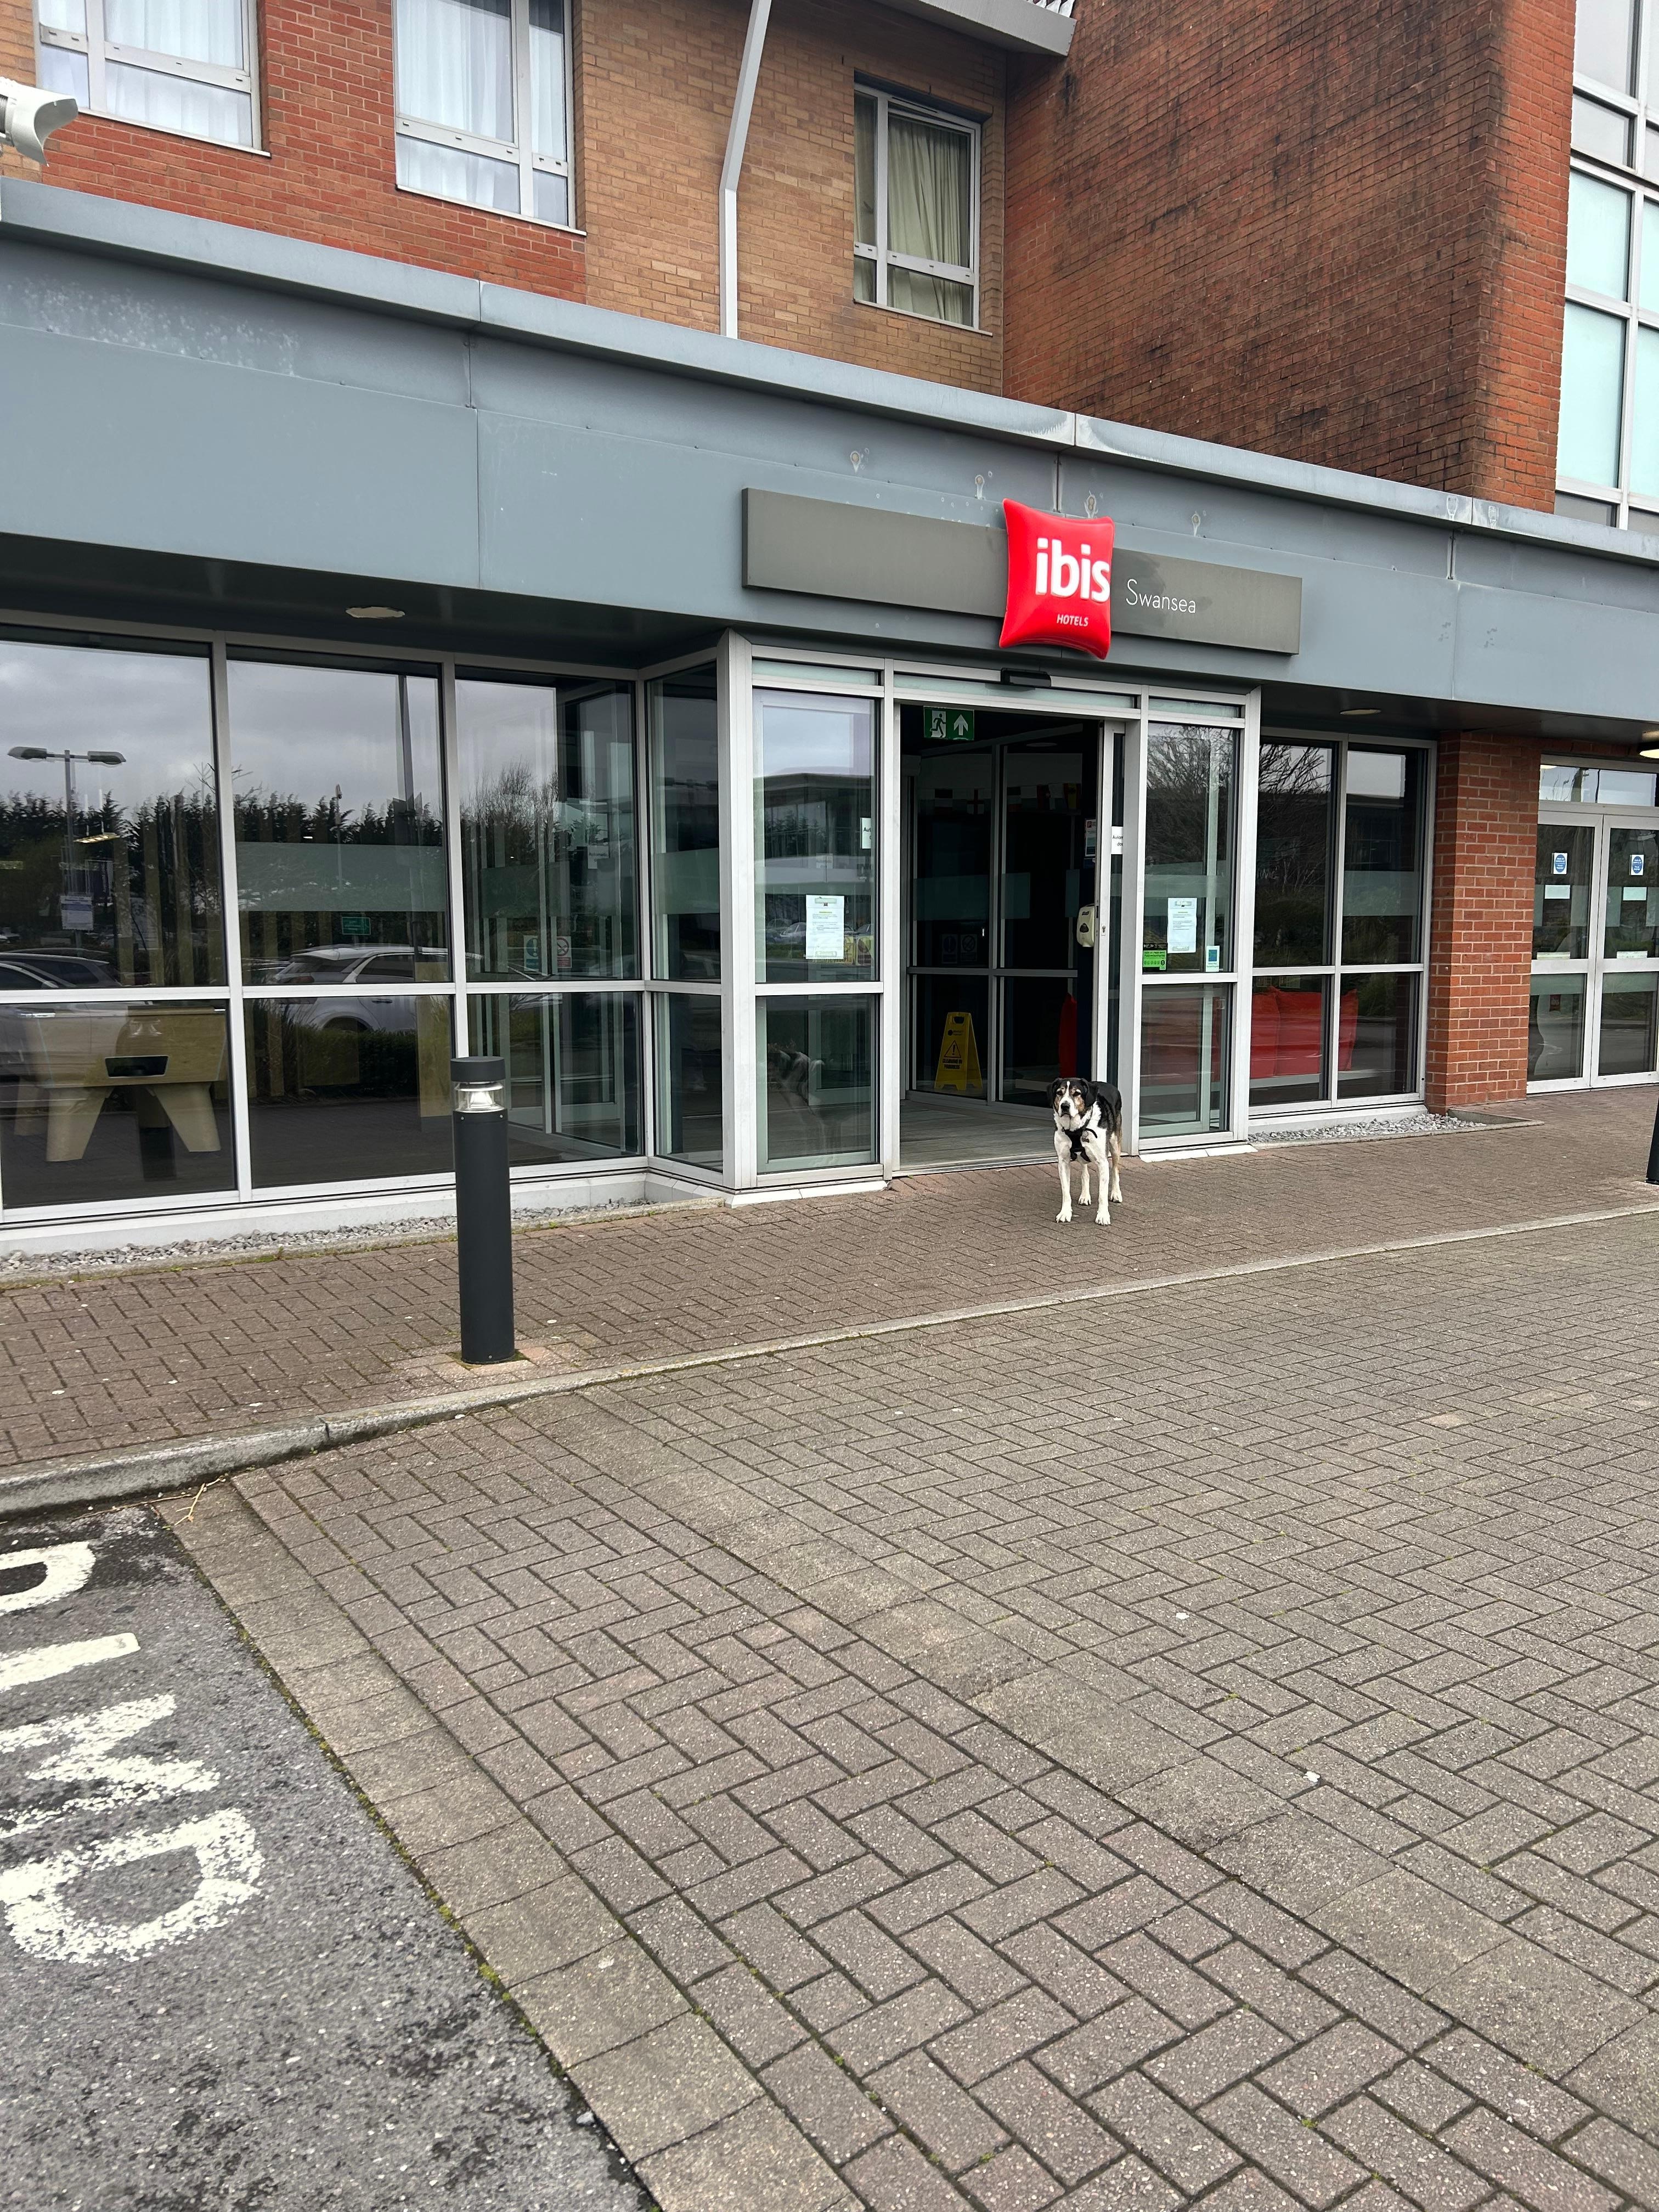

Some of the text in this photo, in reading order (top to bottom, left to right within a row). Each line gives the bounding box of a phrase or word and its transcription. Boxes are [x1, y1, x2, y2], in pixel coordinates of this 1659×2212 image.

[1035, 537, 1111, 603] ibis
[1125, 578, 1197, 614] Swansea
[1056, 614, 1089, 627] HOTELS
